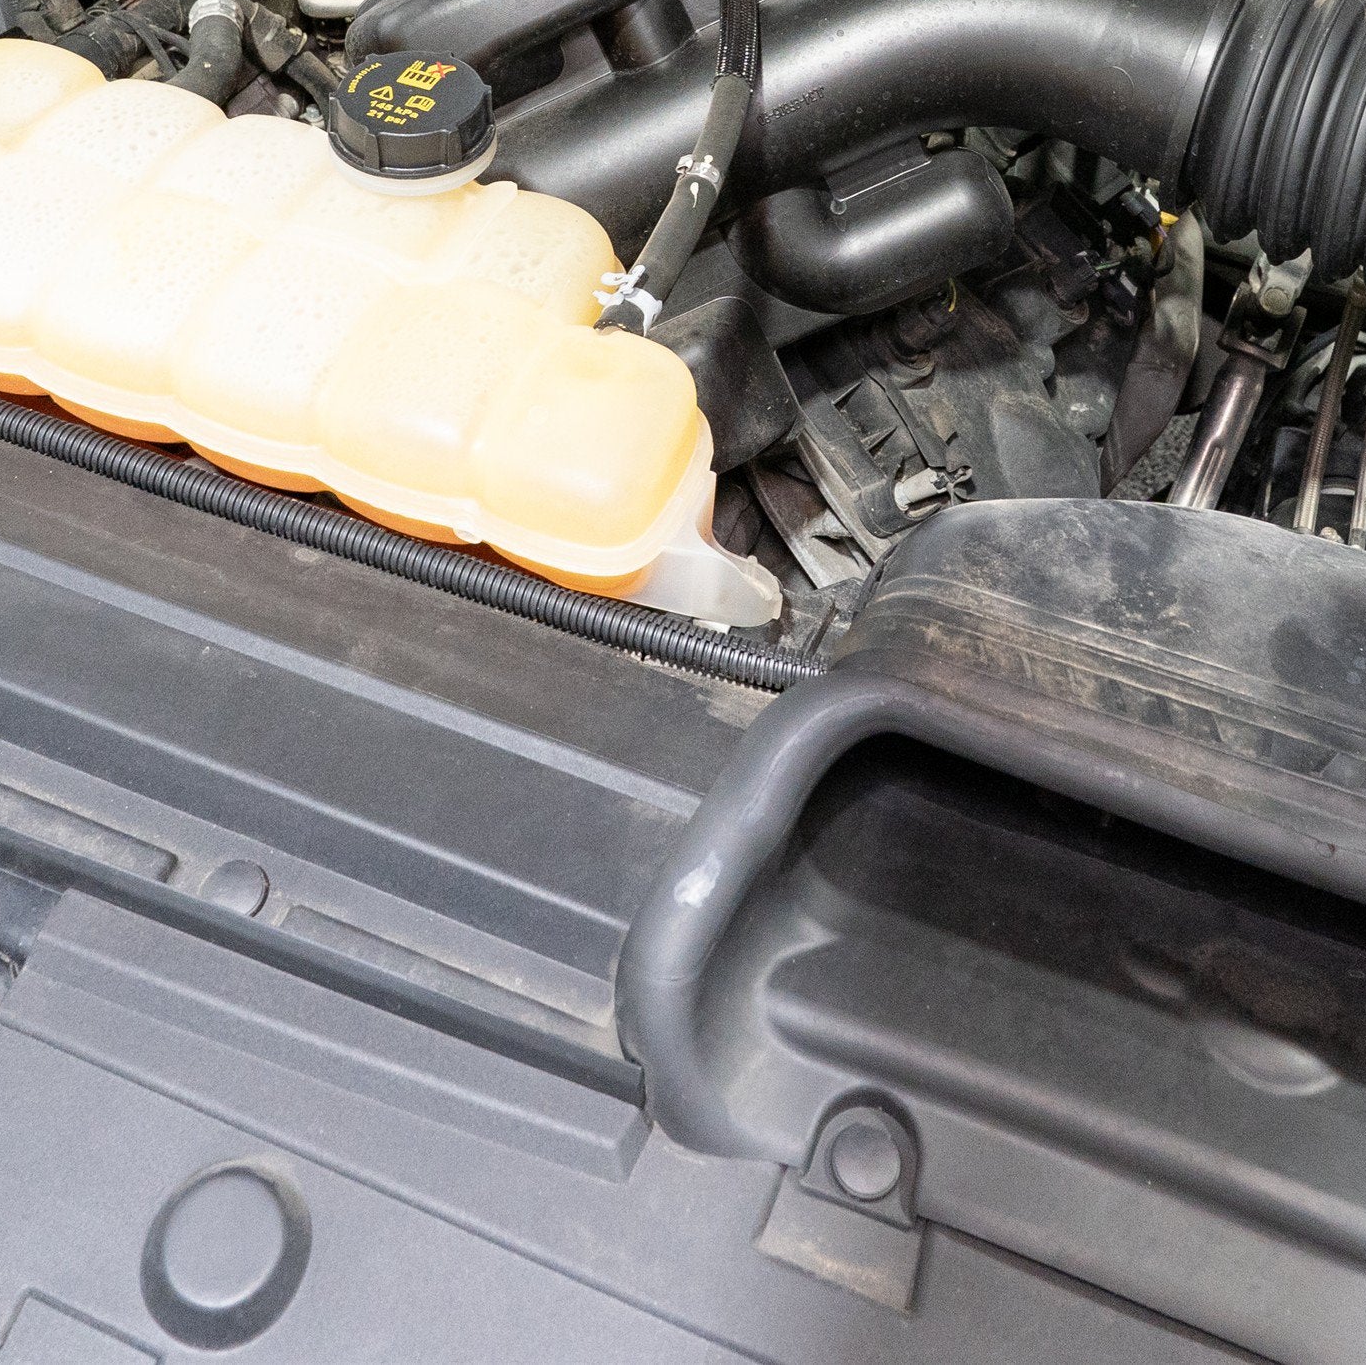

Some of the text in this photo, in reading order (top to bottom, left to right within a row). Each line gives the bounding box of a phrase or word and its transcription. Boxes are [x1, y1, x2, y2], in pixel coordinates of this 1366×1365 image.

[366, 109, 407, 125] 21 psi
[369, 100, 419, 119] 145 kPa
